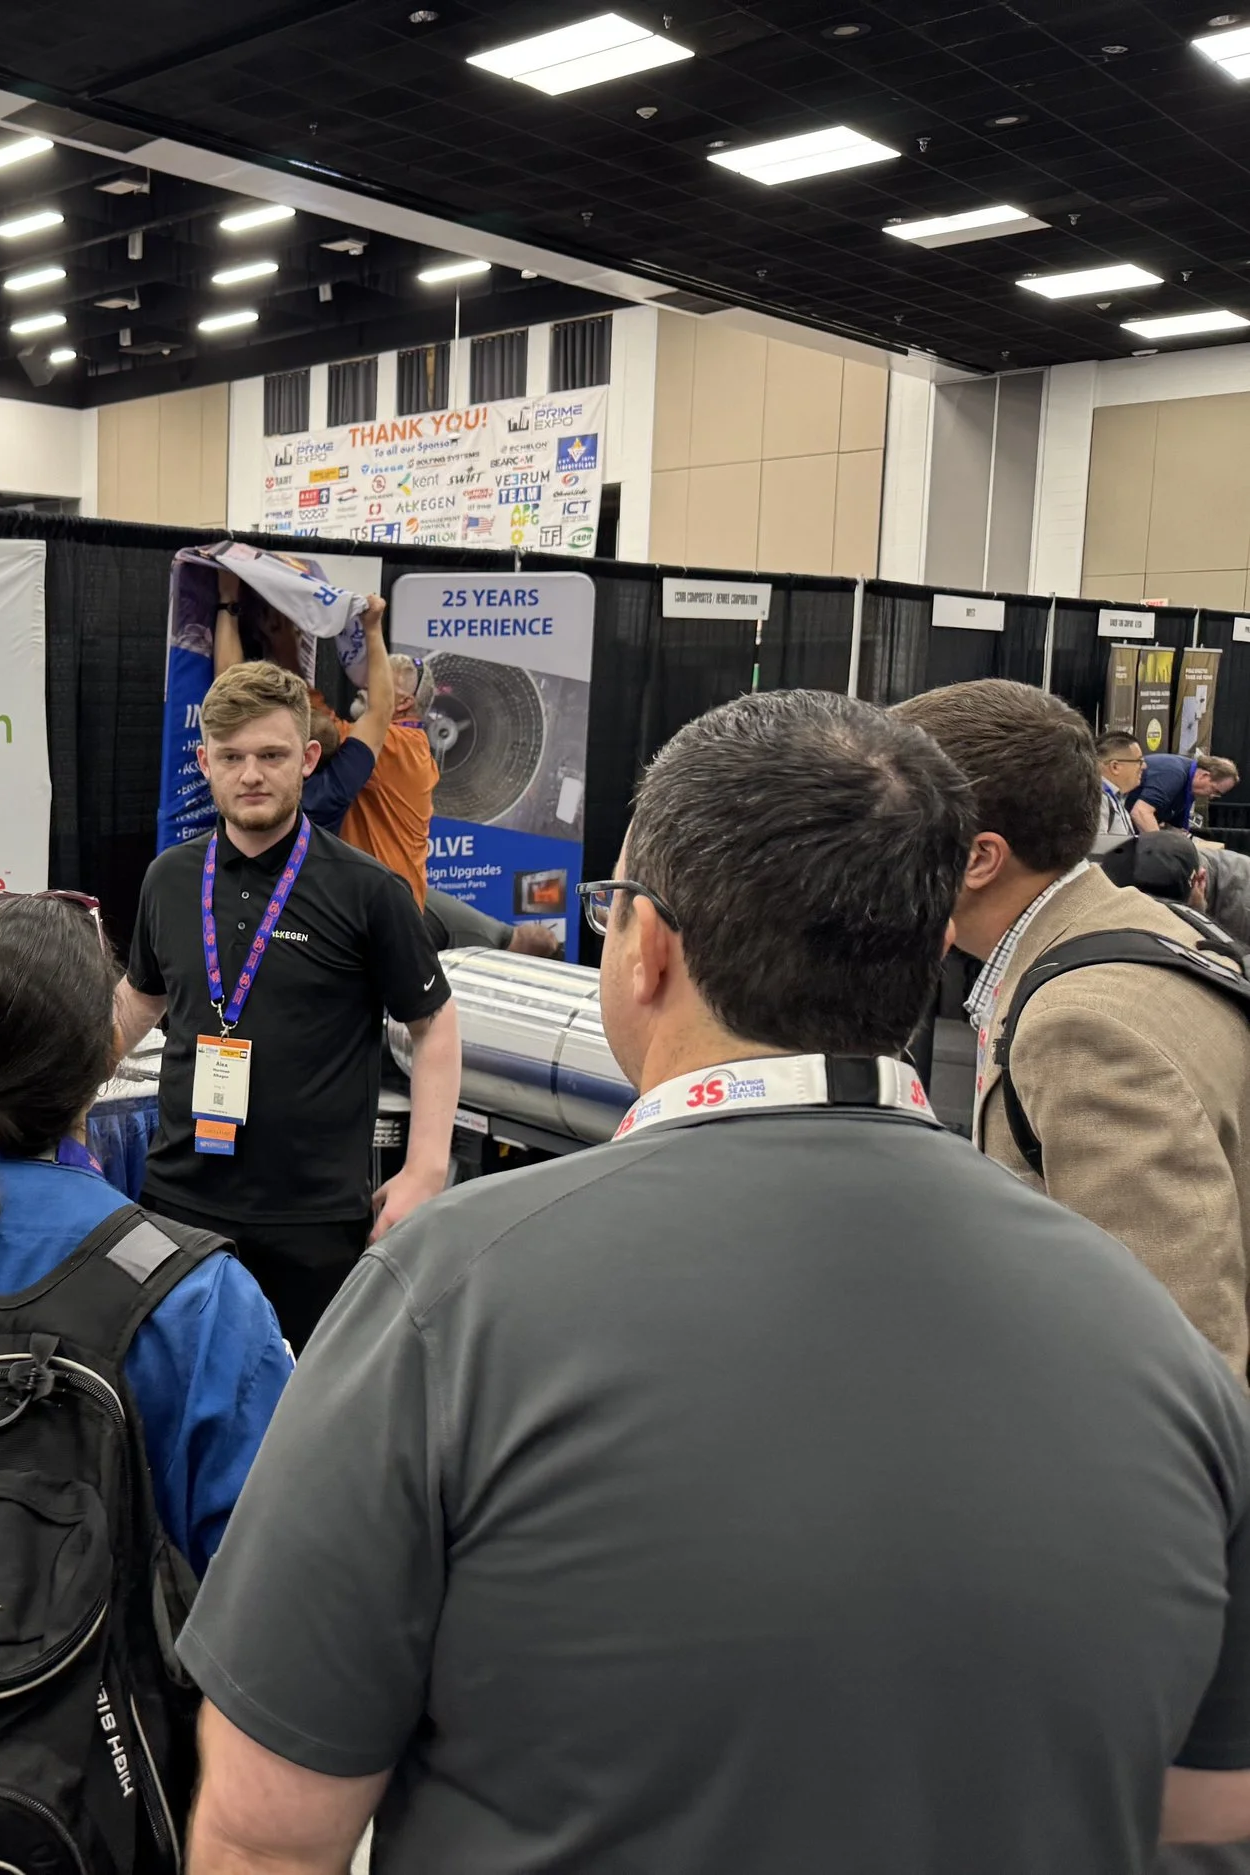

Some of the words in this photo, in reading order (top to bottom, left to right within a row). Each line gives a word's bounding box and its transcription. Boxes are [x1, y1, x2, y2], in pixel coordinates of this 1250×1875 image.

[535, 404, 583, 421] PRIME
[349, 418, 424, 448] THANK
[430, 407, 488, 436] YOU!
[534, 416, 574, 431] EXPO
[297, 442, 334, 455] PRIME
[386, 446, 398, 456] all
[400, 444, 416, 454] our
[296, 453, 327, 465] EXPO
[412, 473, 440, 489] kent
[500, 487, 538, 503] TEAM
[395, 495, 456, 515] ALKEGEN
[562, 501, 591, 515] ICT
[442, 590, 467, 607] 25
[473, 589, 539, 607] YEARS
[427, 618, 553, 637] EXPERIENCE
[450, 864, 502, 878] Upgrades
[728, 1078, 764, 1088] SUPERIOR
[728, 1085, 765, 1094] SEALING
[686, 1080, 724, 1108] 3S
[729, 1091, 766, 1100] SERVICES
[107, 1735, 134, 1798] HIGH
